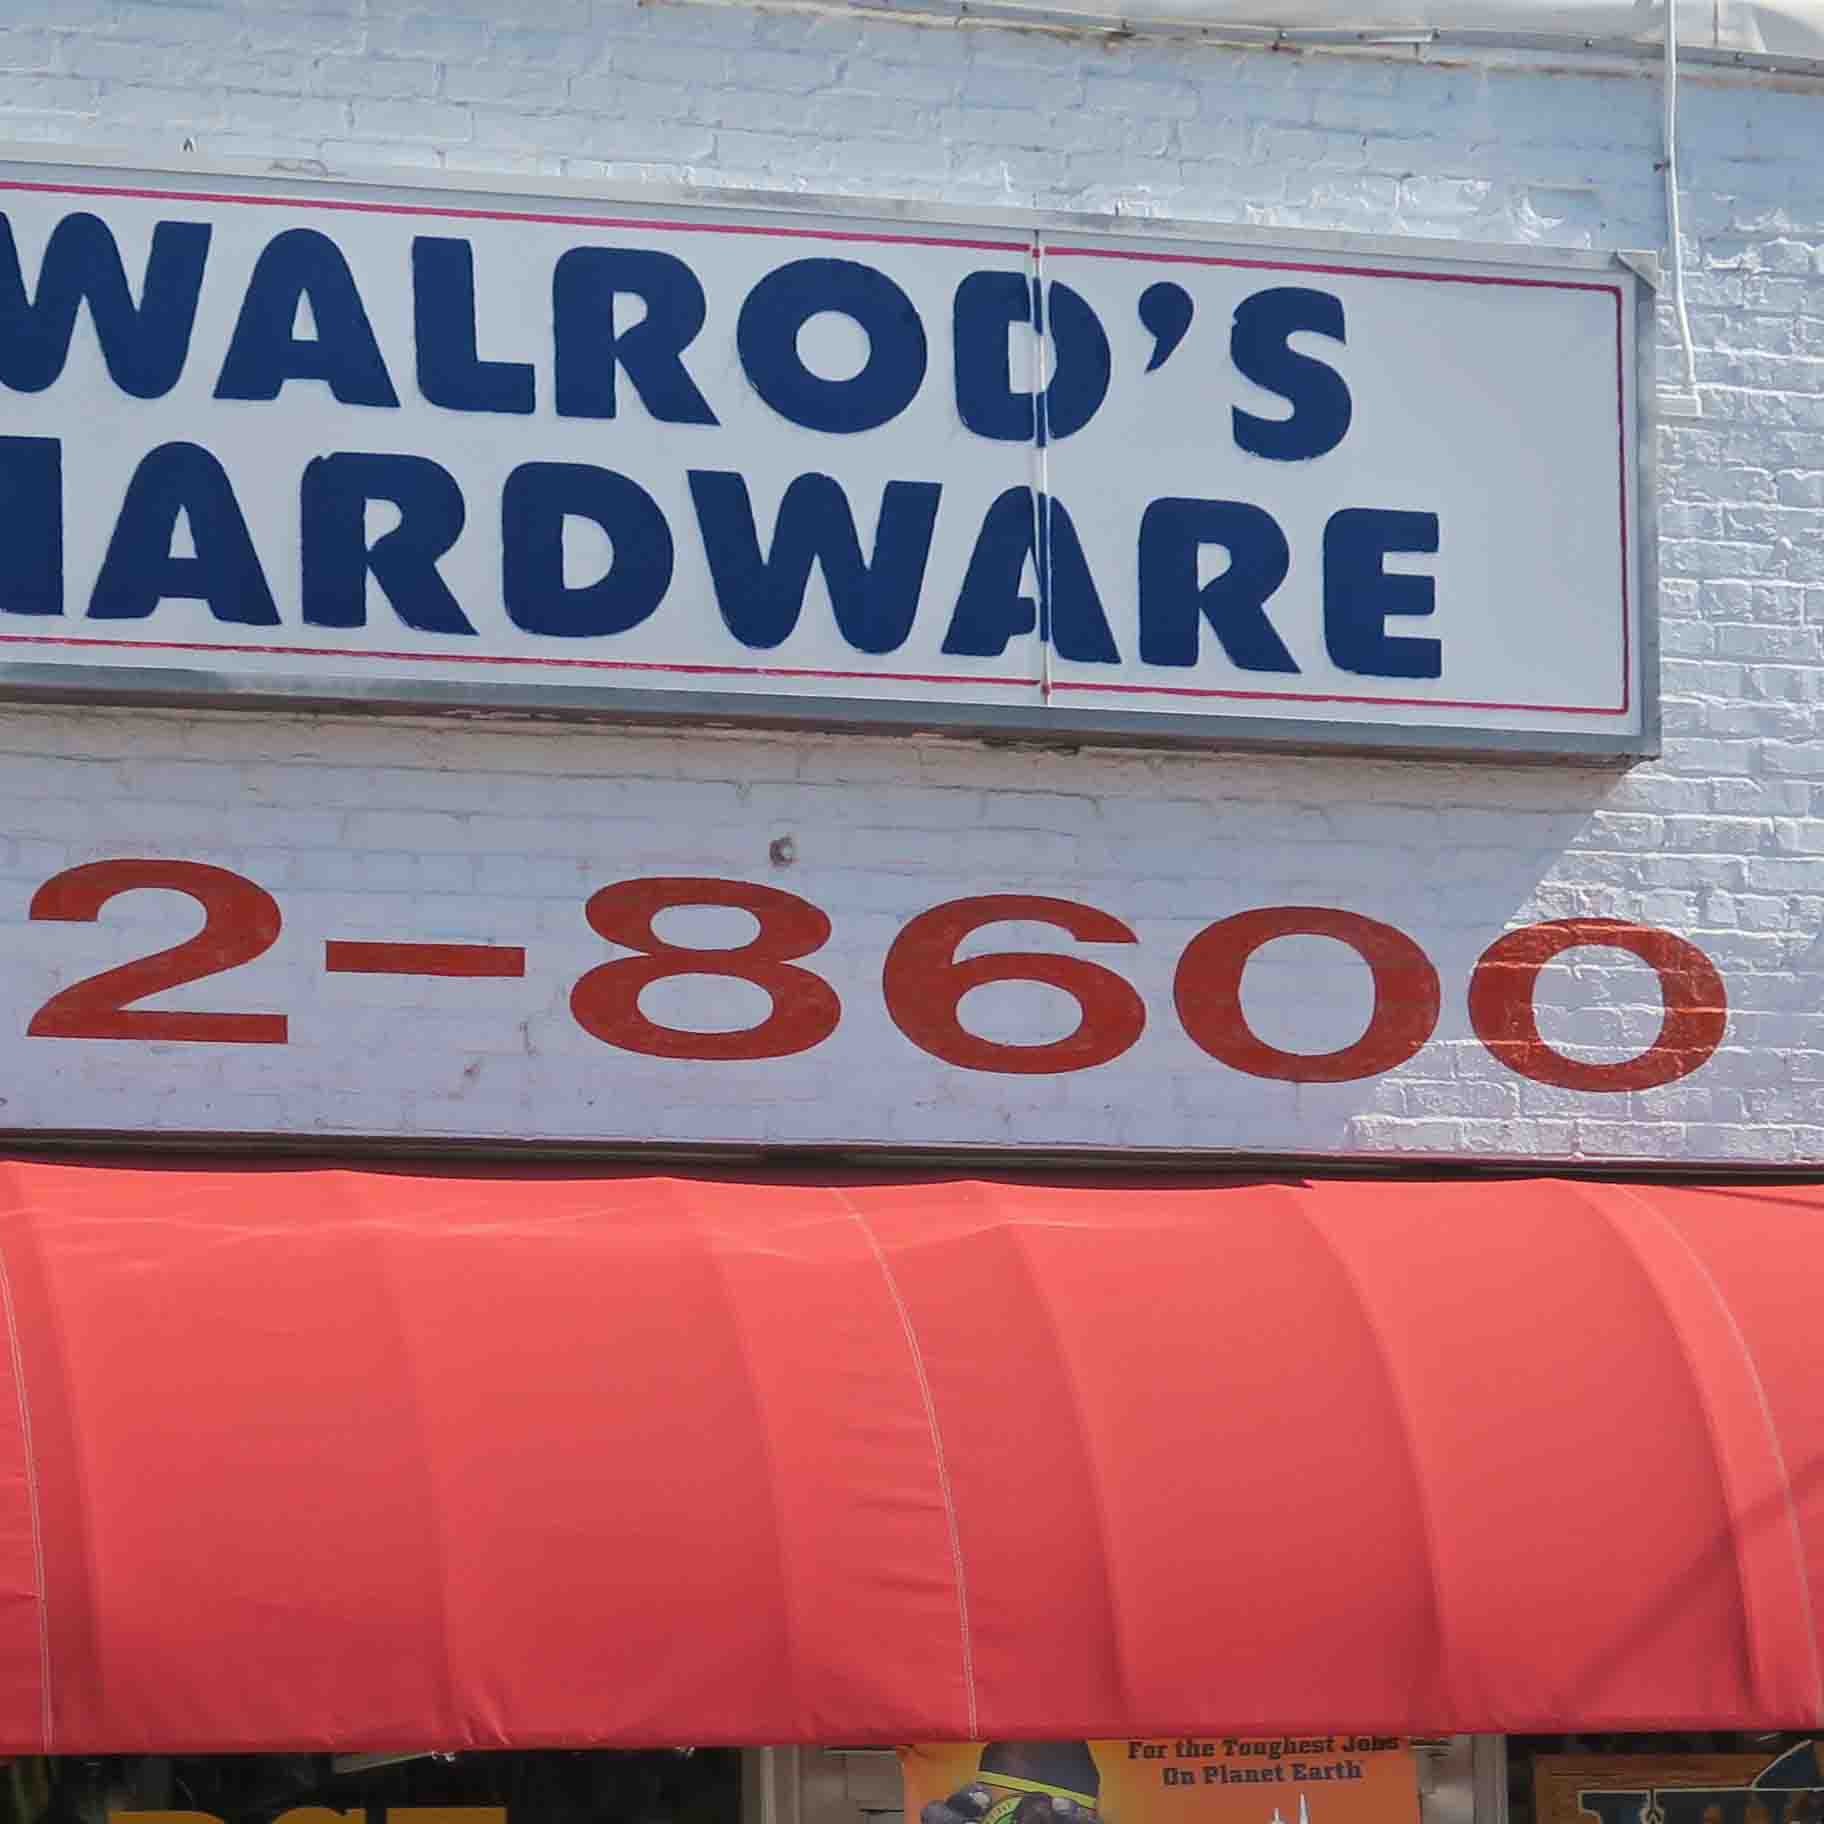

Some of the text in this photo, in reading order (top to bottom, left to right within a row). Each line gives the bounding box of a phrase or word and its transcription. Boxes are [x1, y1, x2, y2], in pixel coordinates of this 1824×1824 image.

[1128, 1740, 1168, 1759] For
[1176, 1737, 1215, 1758] the
[1222, 1734, 1336, 1760] Toughest
[1163, 1760, 1363, 1786] On Planet Earth
